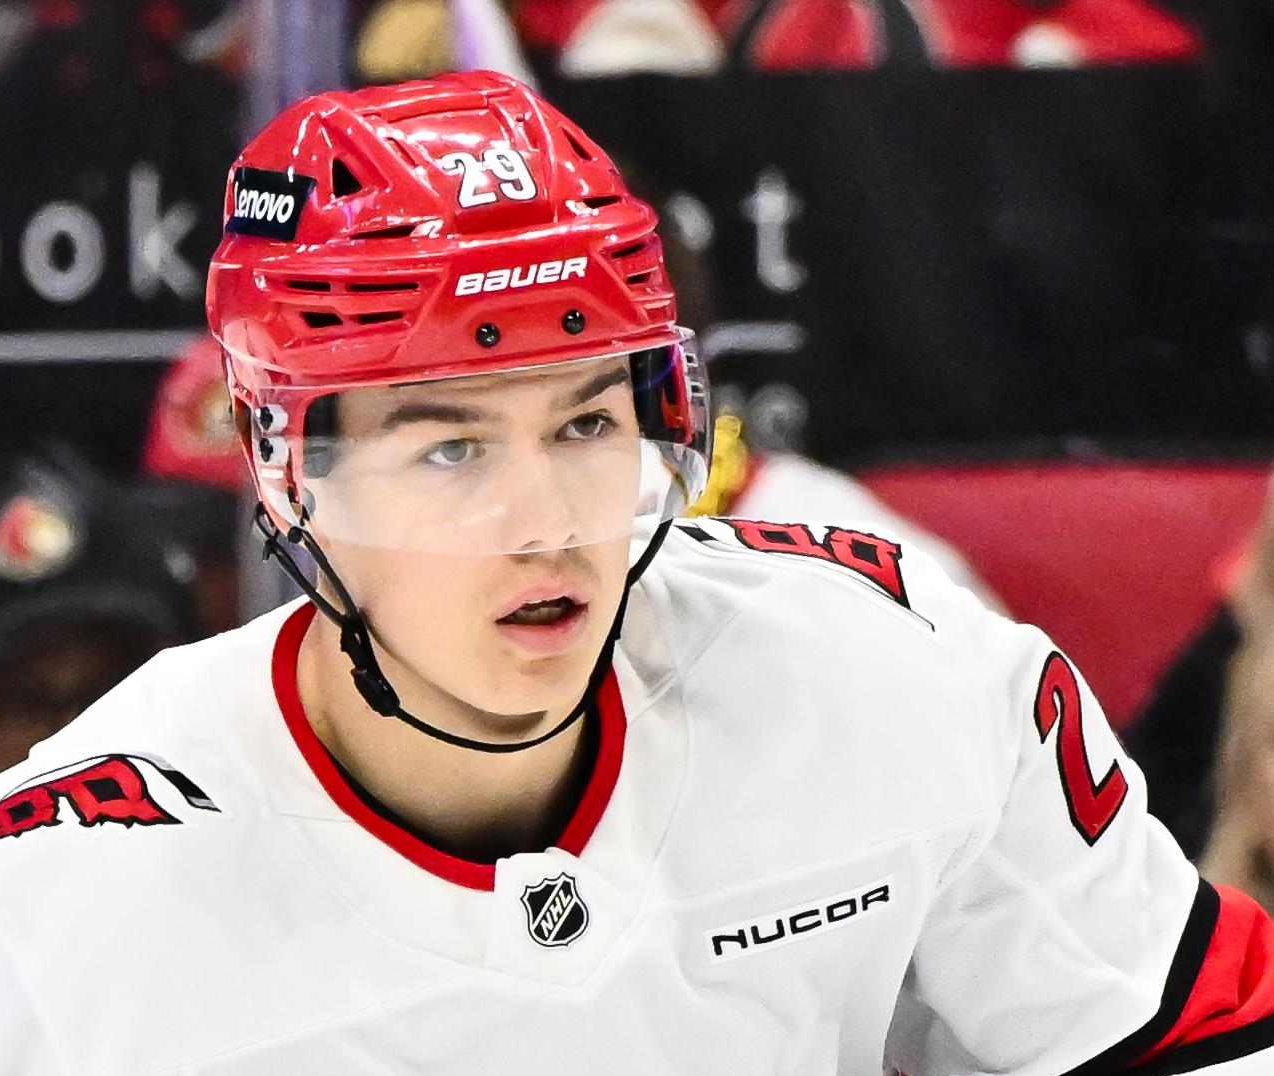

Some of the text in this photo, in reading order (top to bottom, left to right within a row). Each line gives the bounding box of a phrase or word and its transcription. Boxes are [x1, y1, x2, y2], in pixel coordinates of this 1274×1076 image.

[233, 182, 295, 223] Lenovo
[440, 149, 539, 209] 29
[540, 889, 573, 938] NHL
[711, 884, 890, 956] NUCOR
